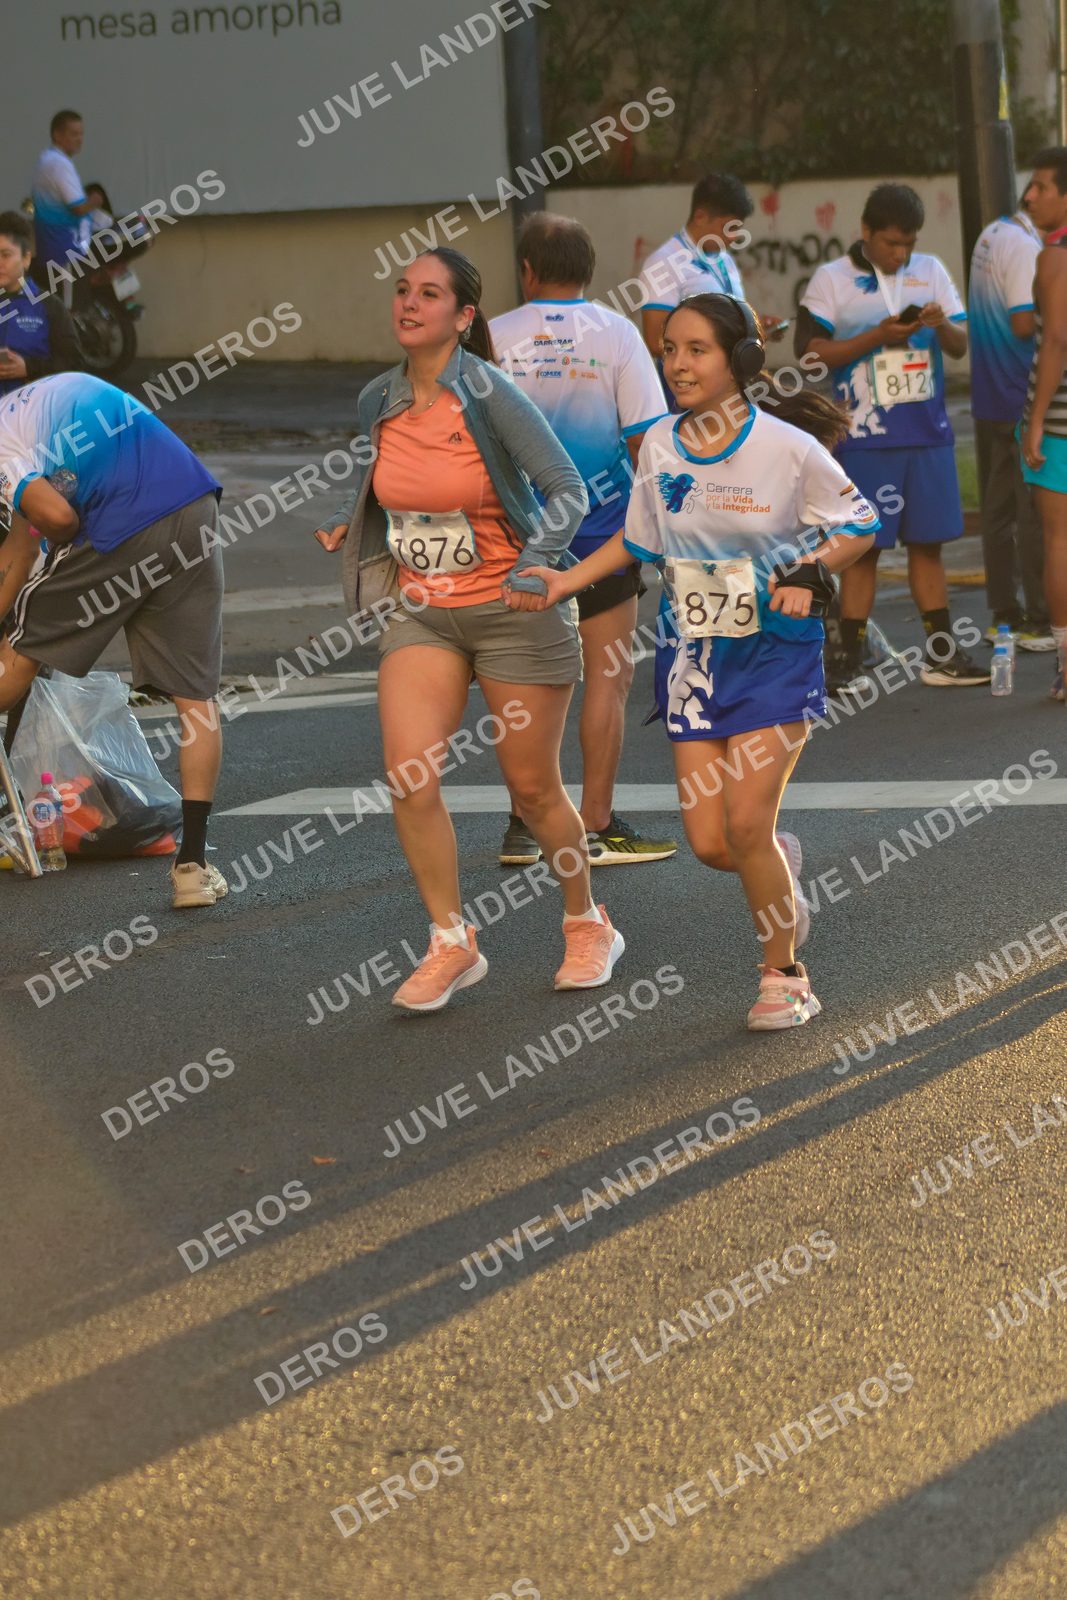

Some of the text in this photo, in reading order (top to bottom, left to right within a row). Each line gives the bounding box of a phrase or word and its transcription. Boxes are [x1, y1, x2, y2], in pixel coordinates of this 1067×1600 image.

[60, 0, 343, 41] mesa amorpha
[886, 372, 927, 397] 812
[706, 483, 753, 495] Carrera
[706, 494, 753, 504] por la Vida
[712, 502, 721, 510] la
[722, 503, 771, 513] Integridad
[685, 591, 754, 627] 875
